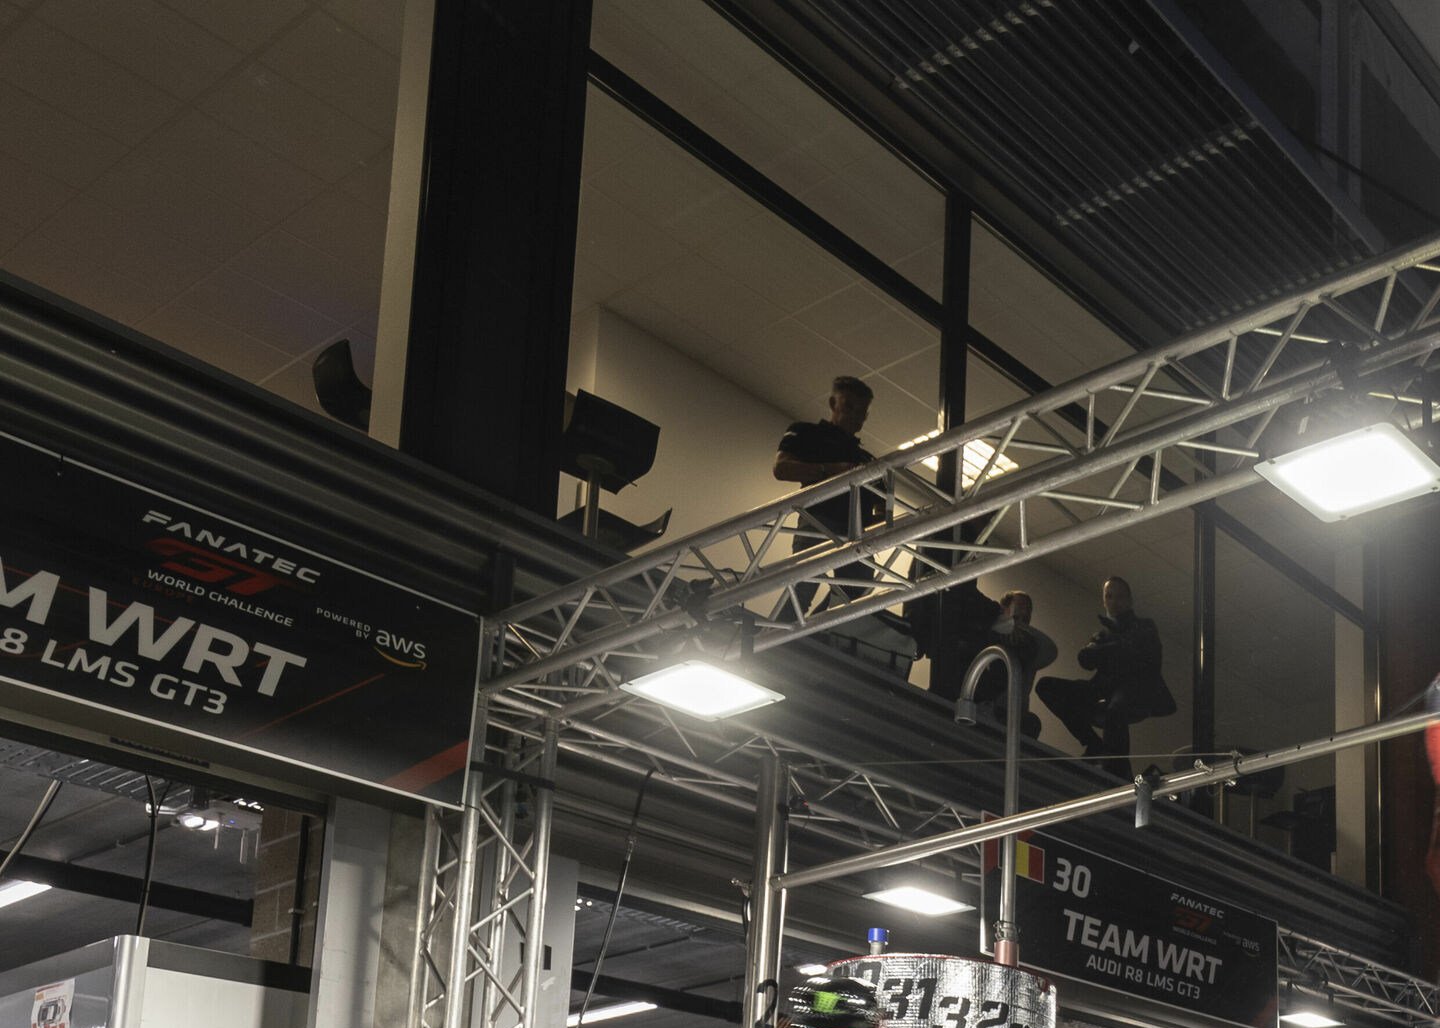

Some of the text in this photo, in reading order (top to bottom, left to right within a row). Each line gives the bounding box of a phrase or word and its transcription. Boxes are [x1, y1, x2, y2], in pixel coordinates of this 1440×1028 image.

[142, 510, 322, 584] FANATEC
[147, 569, 294, 627] WORLD CHALLENGE
[316, 607, 371, 632] POWERED
[89, 586, 307, 697] WRT
[355, 629, 370, 641] BY
[375, 628, 427, 660] aws
[40, 639, 139, 688] LMS
[150, 673, 228, 715] GT3
[1053, 857, 1092, 899] 30
[1170, 892, 1225, 919] FANATEC
[1063, 908, 1222, 985] TEAM WRT
[883, 978, 937, 1020] 31
[1086, 954, 1201, 1000] AUDI R8 LMS GT3
